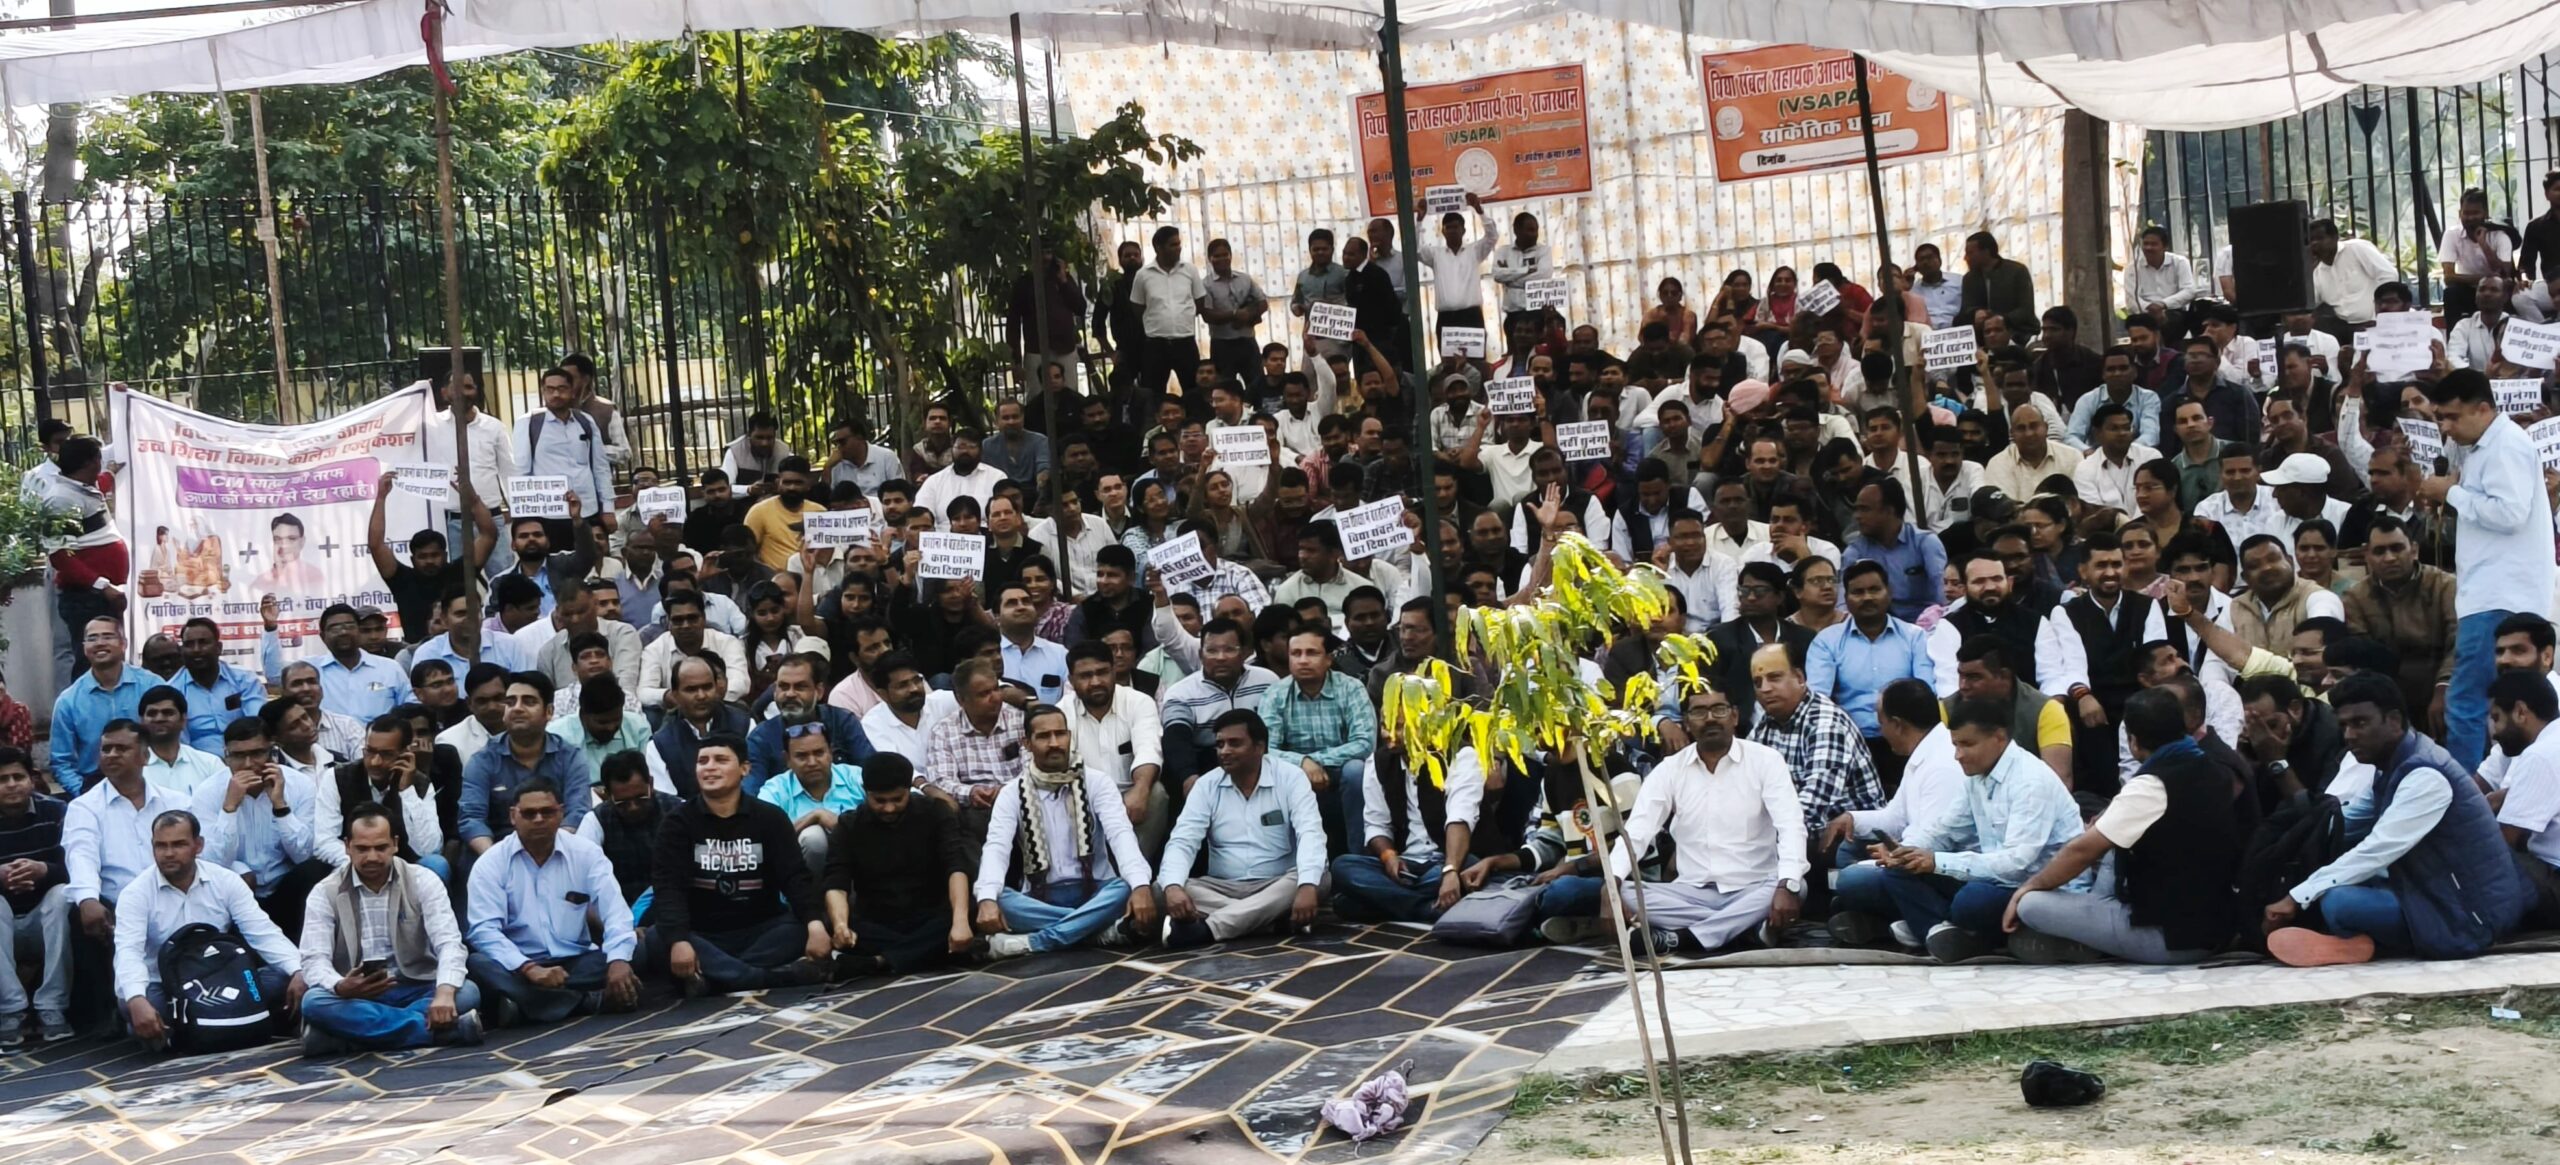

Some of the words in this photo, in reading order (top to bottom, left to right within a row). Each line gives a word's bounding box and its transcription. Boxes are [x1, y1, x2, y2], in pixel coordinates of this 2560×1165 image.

[1771, 63, 1815, 92] सहायक
[1421, 103, 1463, 129] सहायक
[1465, 89, 1502, 122] आचार्य
[1529, 87, 1580, 113] राजस्थान
[1847, 111, 1892, 133] धना
[1444, 125, 1502, 148] (VSAPA)
[331, 484, 355, 499] रहा
[351, 590, 396, 608] सुनिश्चि
